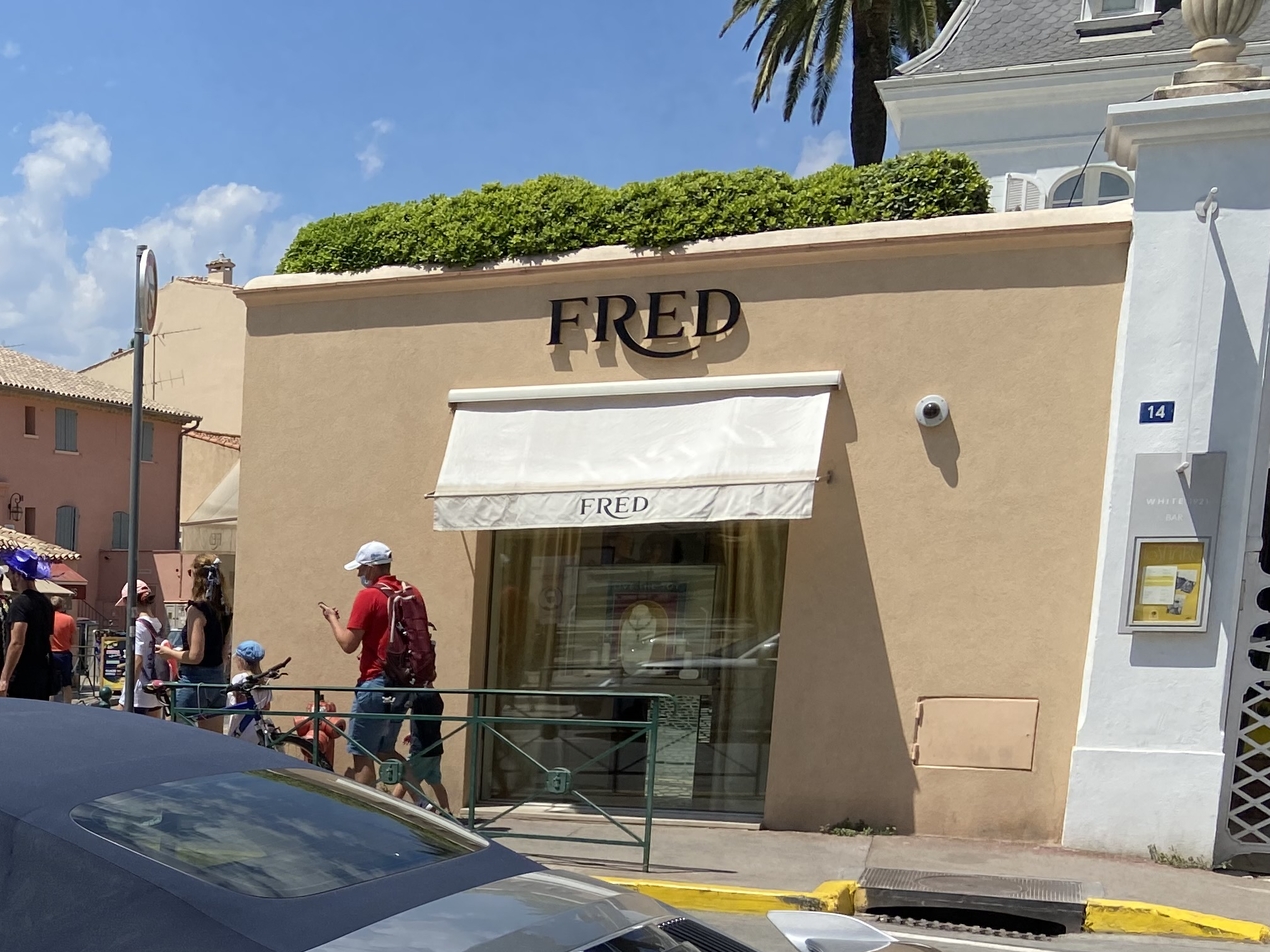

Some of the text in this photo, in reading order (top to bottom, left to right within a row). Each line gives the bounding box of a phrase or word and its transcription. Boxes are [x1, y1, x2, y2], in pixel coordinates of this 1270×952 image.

[546, 288, 741, 358] FRED
[1147, 405, 1166, 419] 14
[579, 496, 649, 519] FRED
[1146, 497, 1184, 505] WHITE
